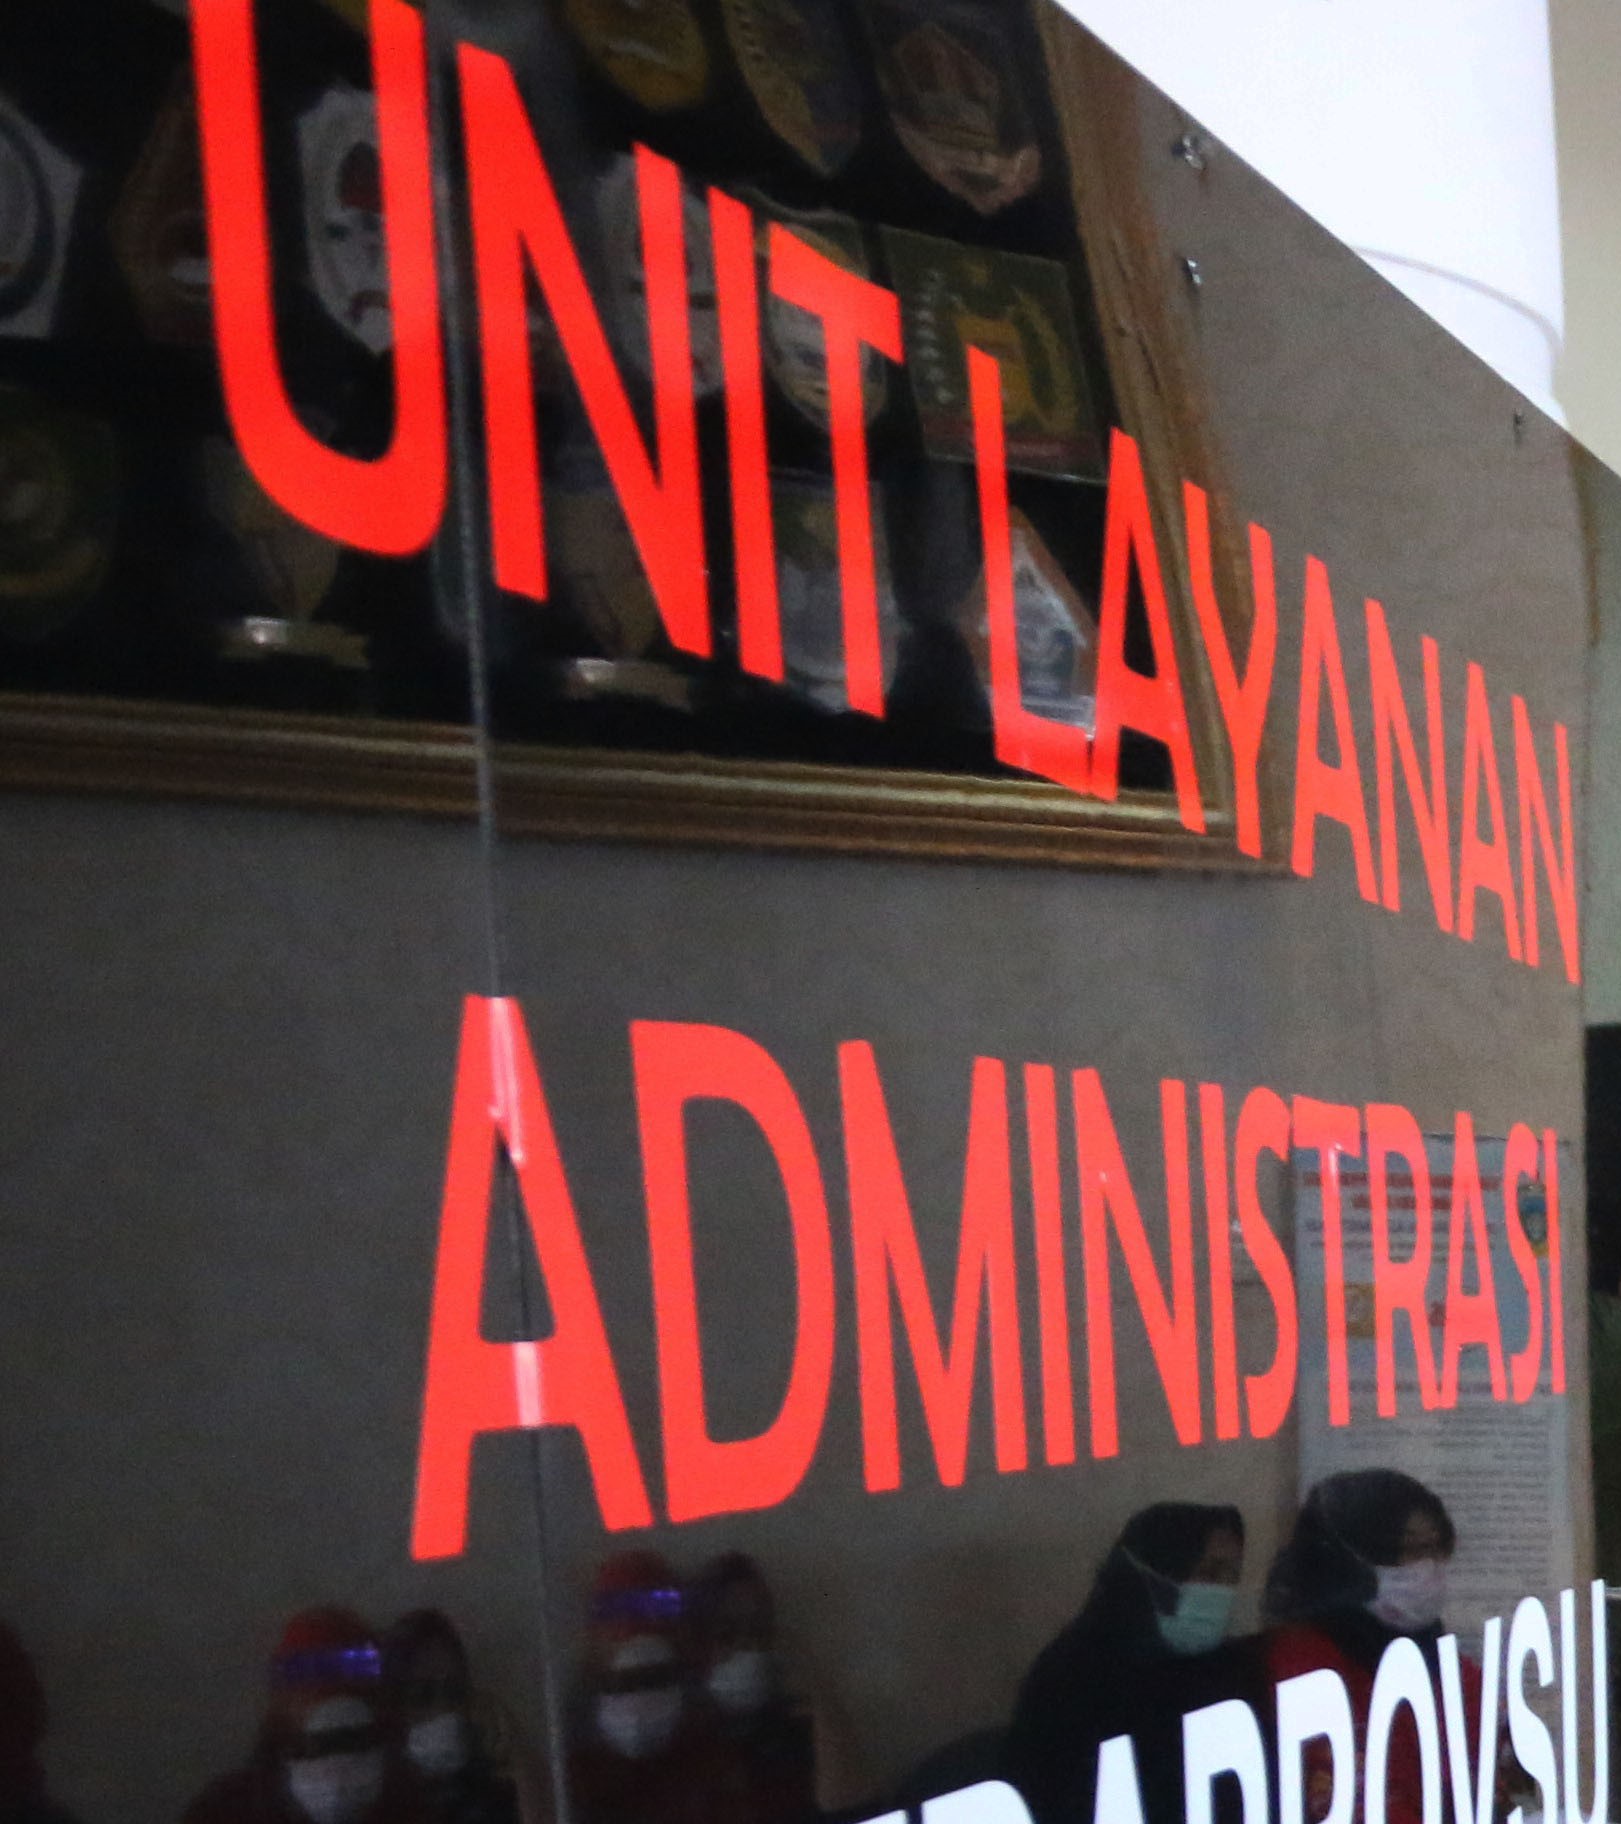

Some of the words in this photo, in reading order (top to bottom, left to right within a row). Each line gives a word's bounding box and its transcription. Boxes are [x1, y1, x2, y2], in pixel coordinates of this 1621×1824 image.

[190, 0, 902, 718] UNIT
[969, 346, 1580, 983] LAYANAN
[410, 994, 1565, 1561] ADMINISTRASI
